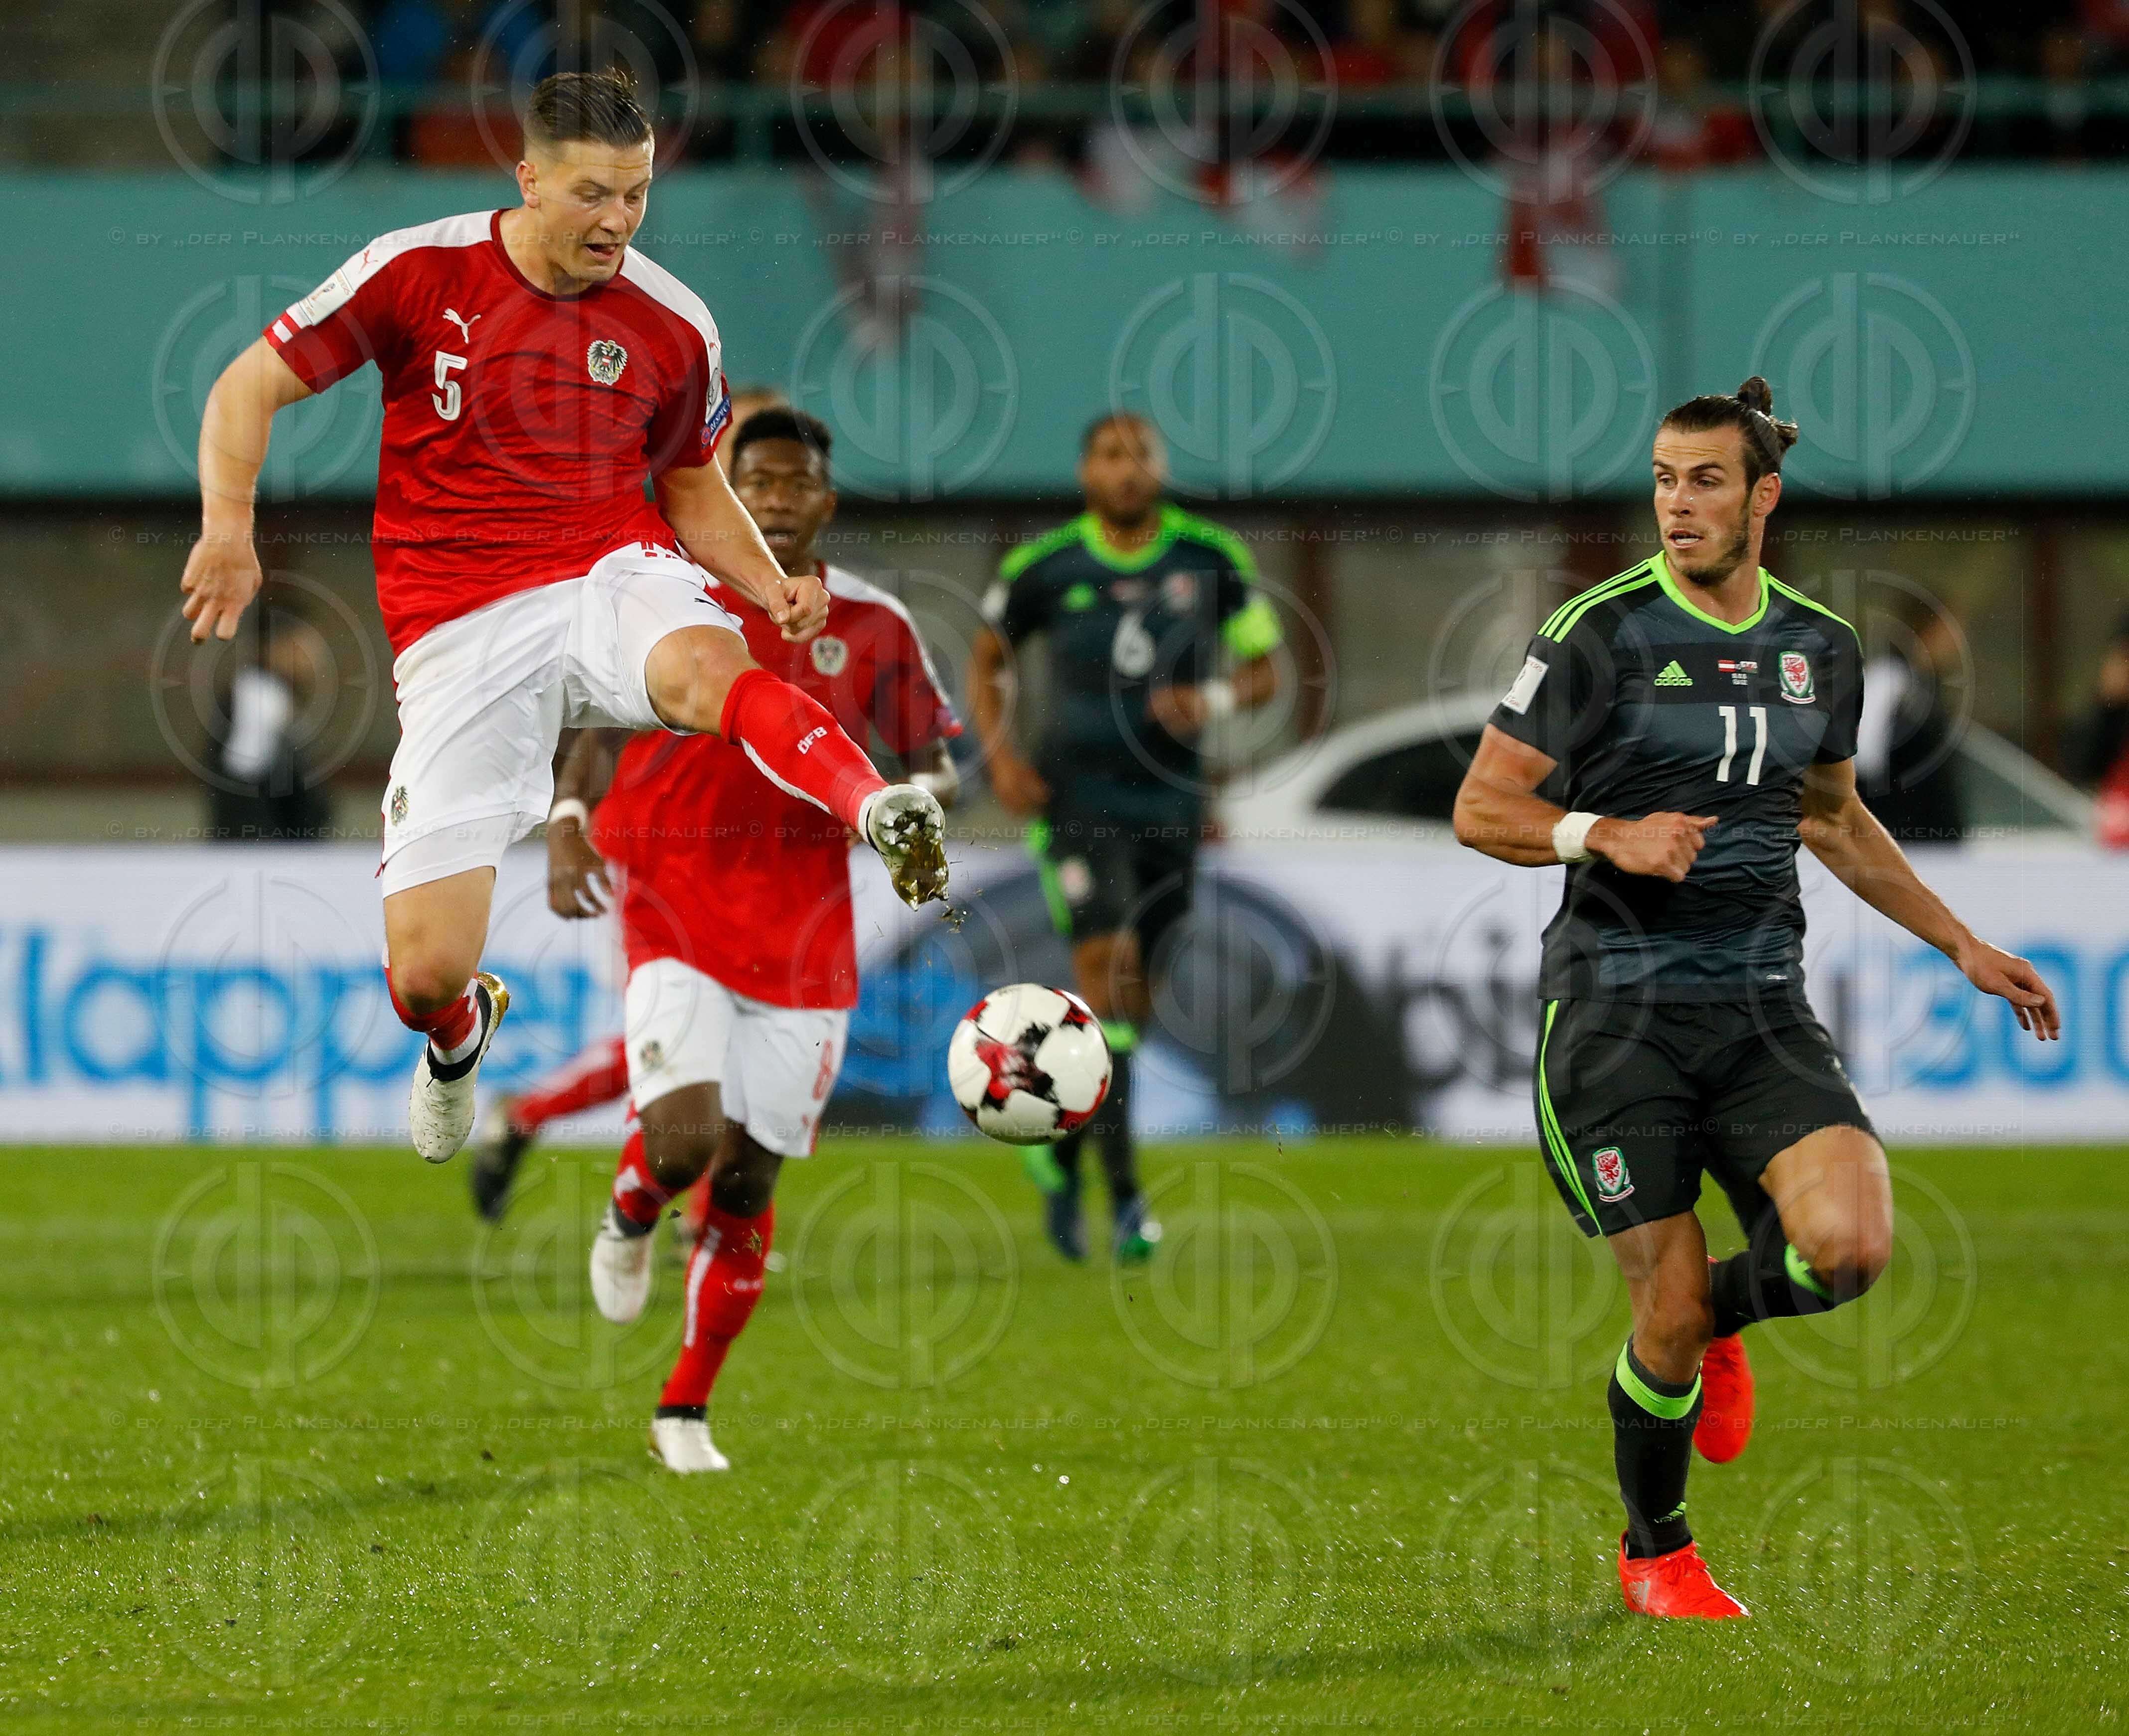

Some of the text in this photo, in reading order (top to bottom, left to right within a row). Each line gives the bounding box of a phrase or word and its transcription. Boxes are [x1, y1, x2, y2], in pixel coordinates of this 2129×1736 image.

[432, 350, 468, 421] 5
[1111, 610, 1156, 677] 6
[1653, 678, 1693, 686] adidas
[1716, 706, 1767, 786] 11
